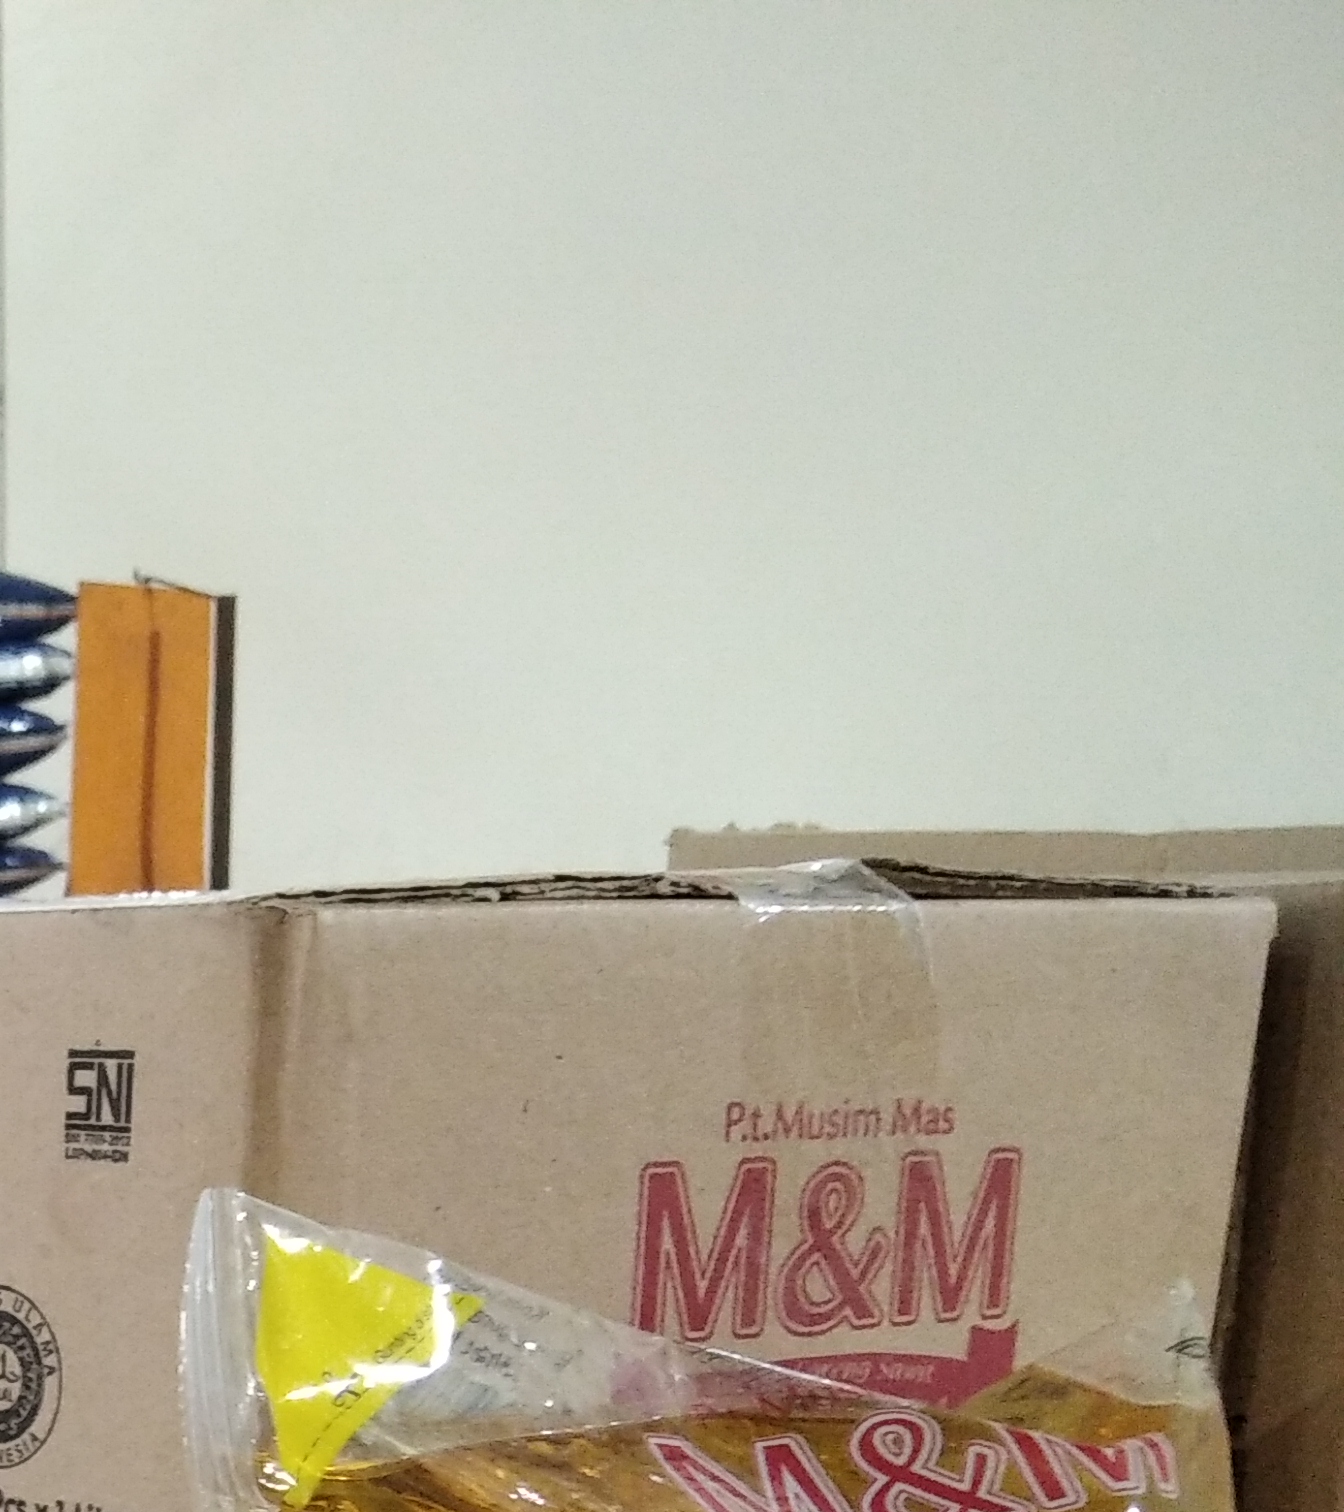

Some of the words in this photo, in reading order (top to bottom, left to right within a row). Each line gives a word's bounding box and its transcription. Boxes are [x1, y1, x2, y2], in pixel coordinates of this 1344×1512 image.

[65, 1061, 134, 1124] SNI
[725, 1099, 882, 1143] P.t.Musim
[891, 1097, 957, 1137] Mas
[632, 1145, 1023, 1343] M&M
[12, 1297, 58, 1378] ULAMA
